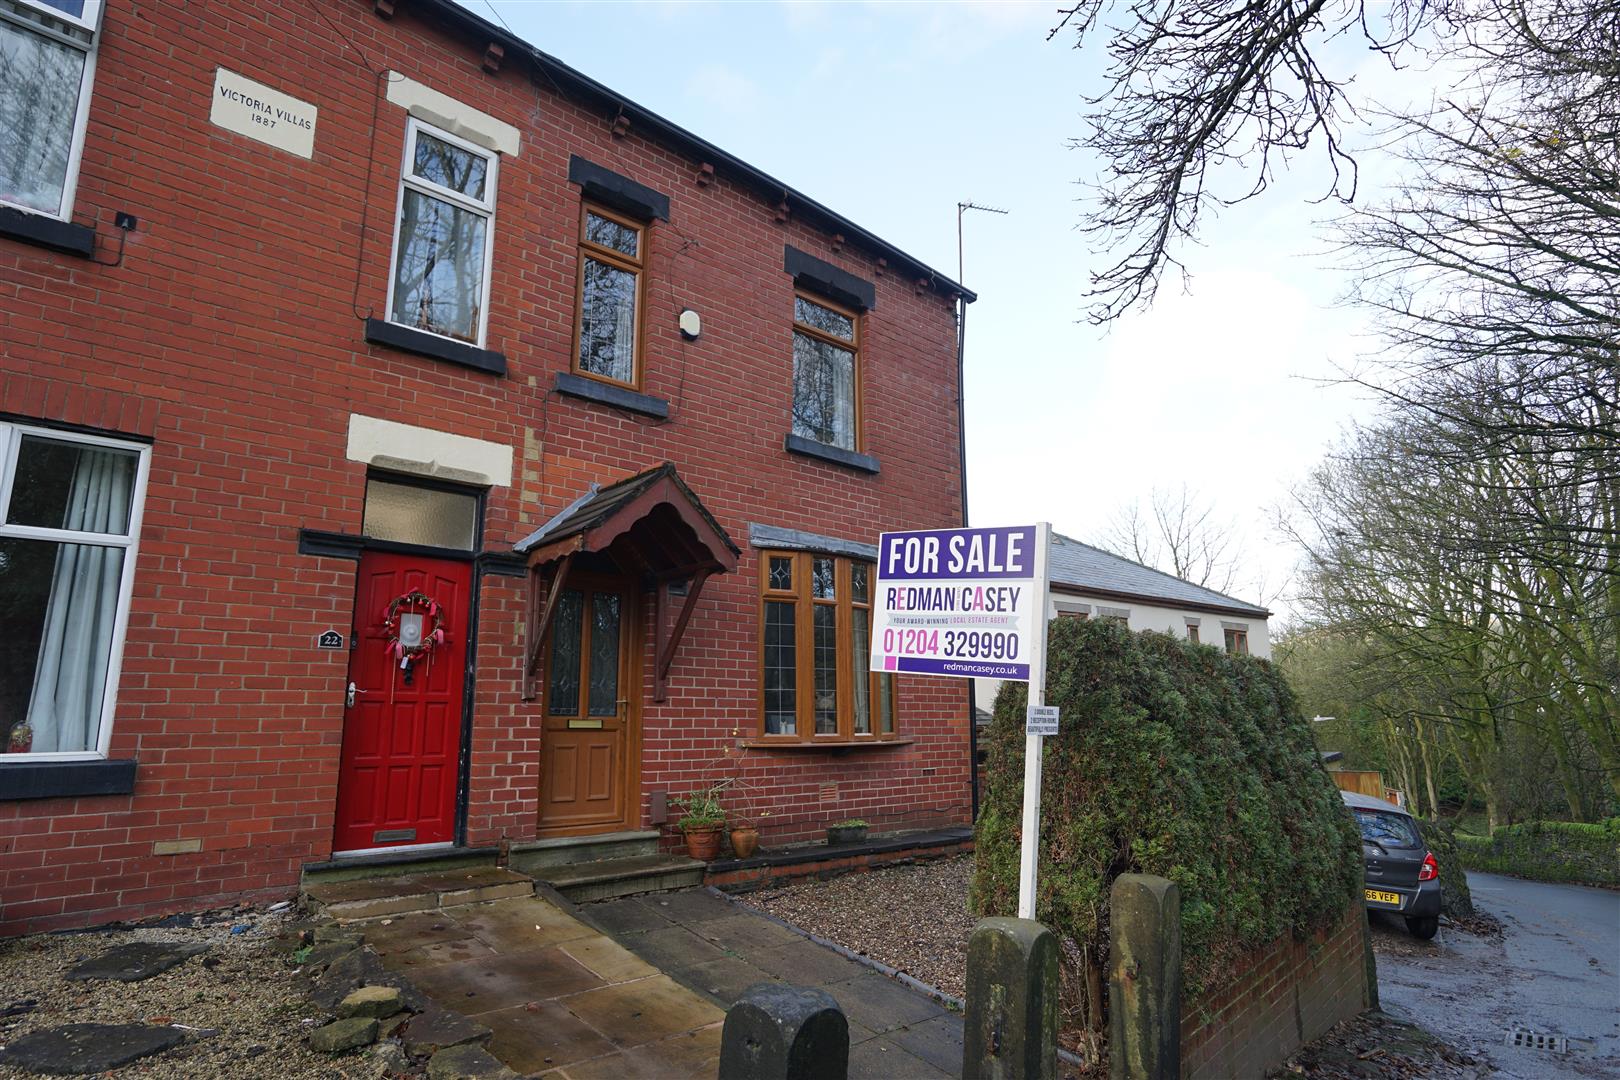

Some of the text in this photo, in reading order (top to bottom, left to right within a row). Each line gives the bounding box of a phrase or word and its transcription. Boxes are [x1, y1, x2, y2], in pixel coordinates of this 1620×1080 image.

[220, 86, 312, 130] VICTORIA VILLAS
[251, 113, 277, 129] 1887
[888, 532, 1025, 574] FOR SALE
[886, 587, 956, 612] REDMAN
[961, 586, 1021, 612] CASEY
[907, 617, 949, 625] AWARD-WINNING
[950, 616, 966, 624] LOCAL
[968, 616, 988, 624] ESTATE
[990, 616, 1009, 625] AGENT
[325, 635, 338, 645] 22
[883, 628, 1019, 660] 01204 329990
[943, 662, 1018, 676] redmancasey.co.uk
[1379, 892, 1395, 902] VEF
